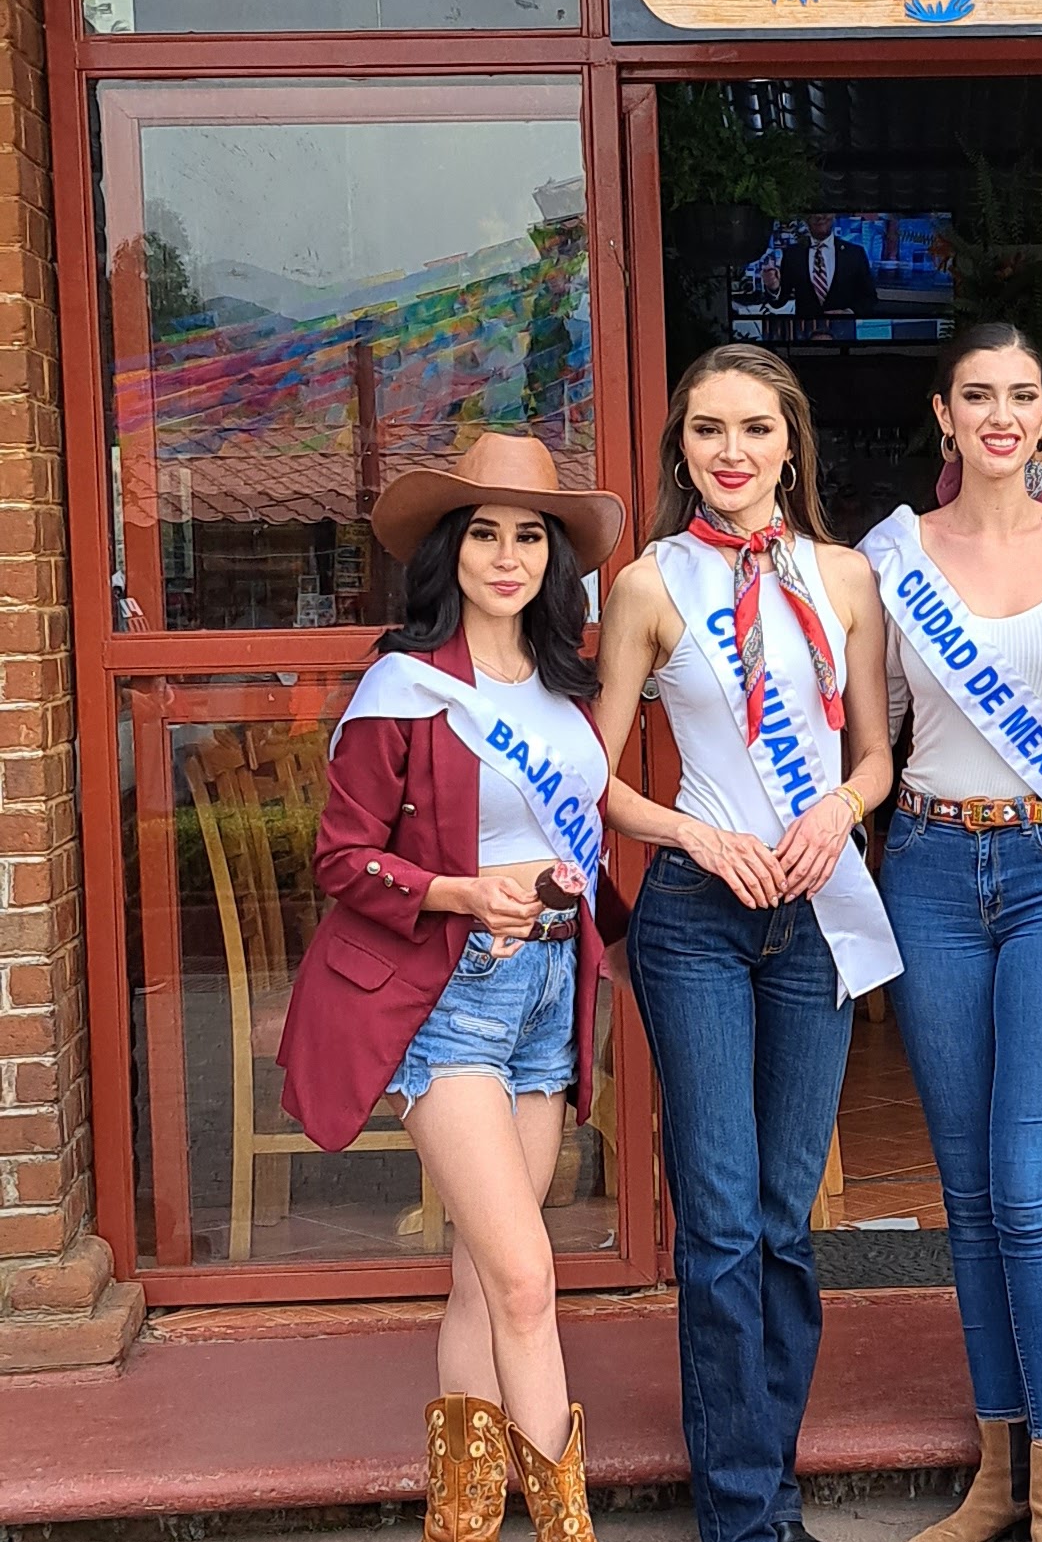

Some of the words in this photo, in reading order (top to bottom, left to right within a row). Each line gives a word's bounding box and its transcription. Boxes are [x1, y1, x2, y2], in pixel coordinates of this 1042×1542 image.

[896, 569, 978, 671] CIUDAD
[964, 665, 1014, 716] DE
[485, 718, 564, 808] BAJA
